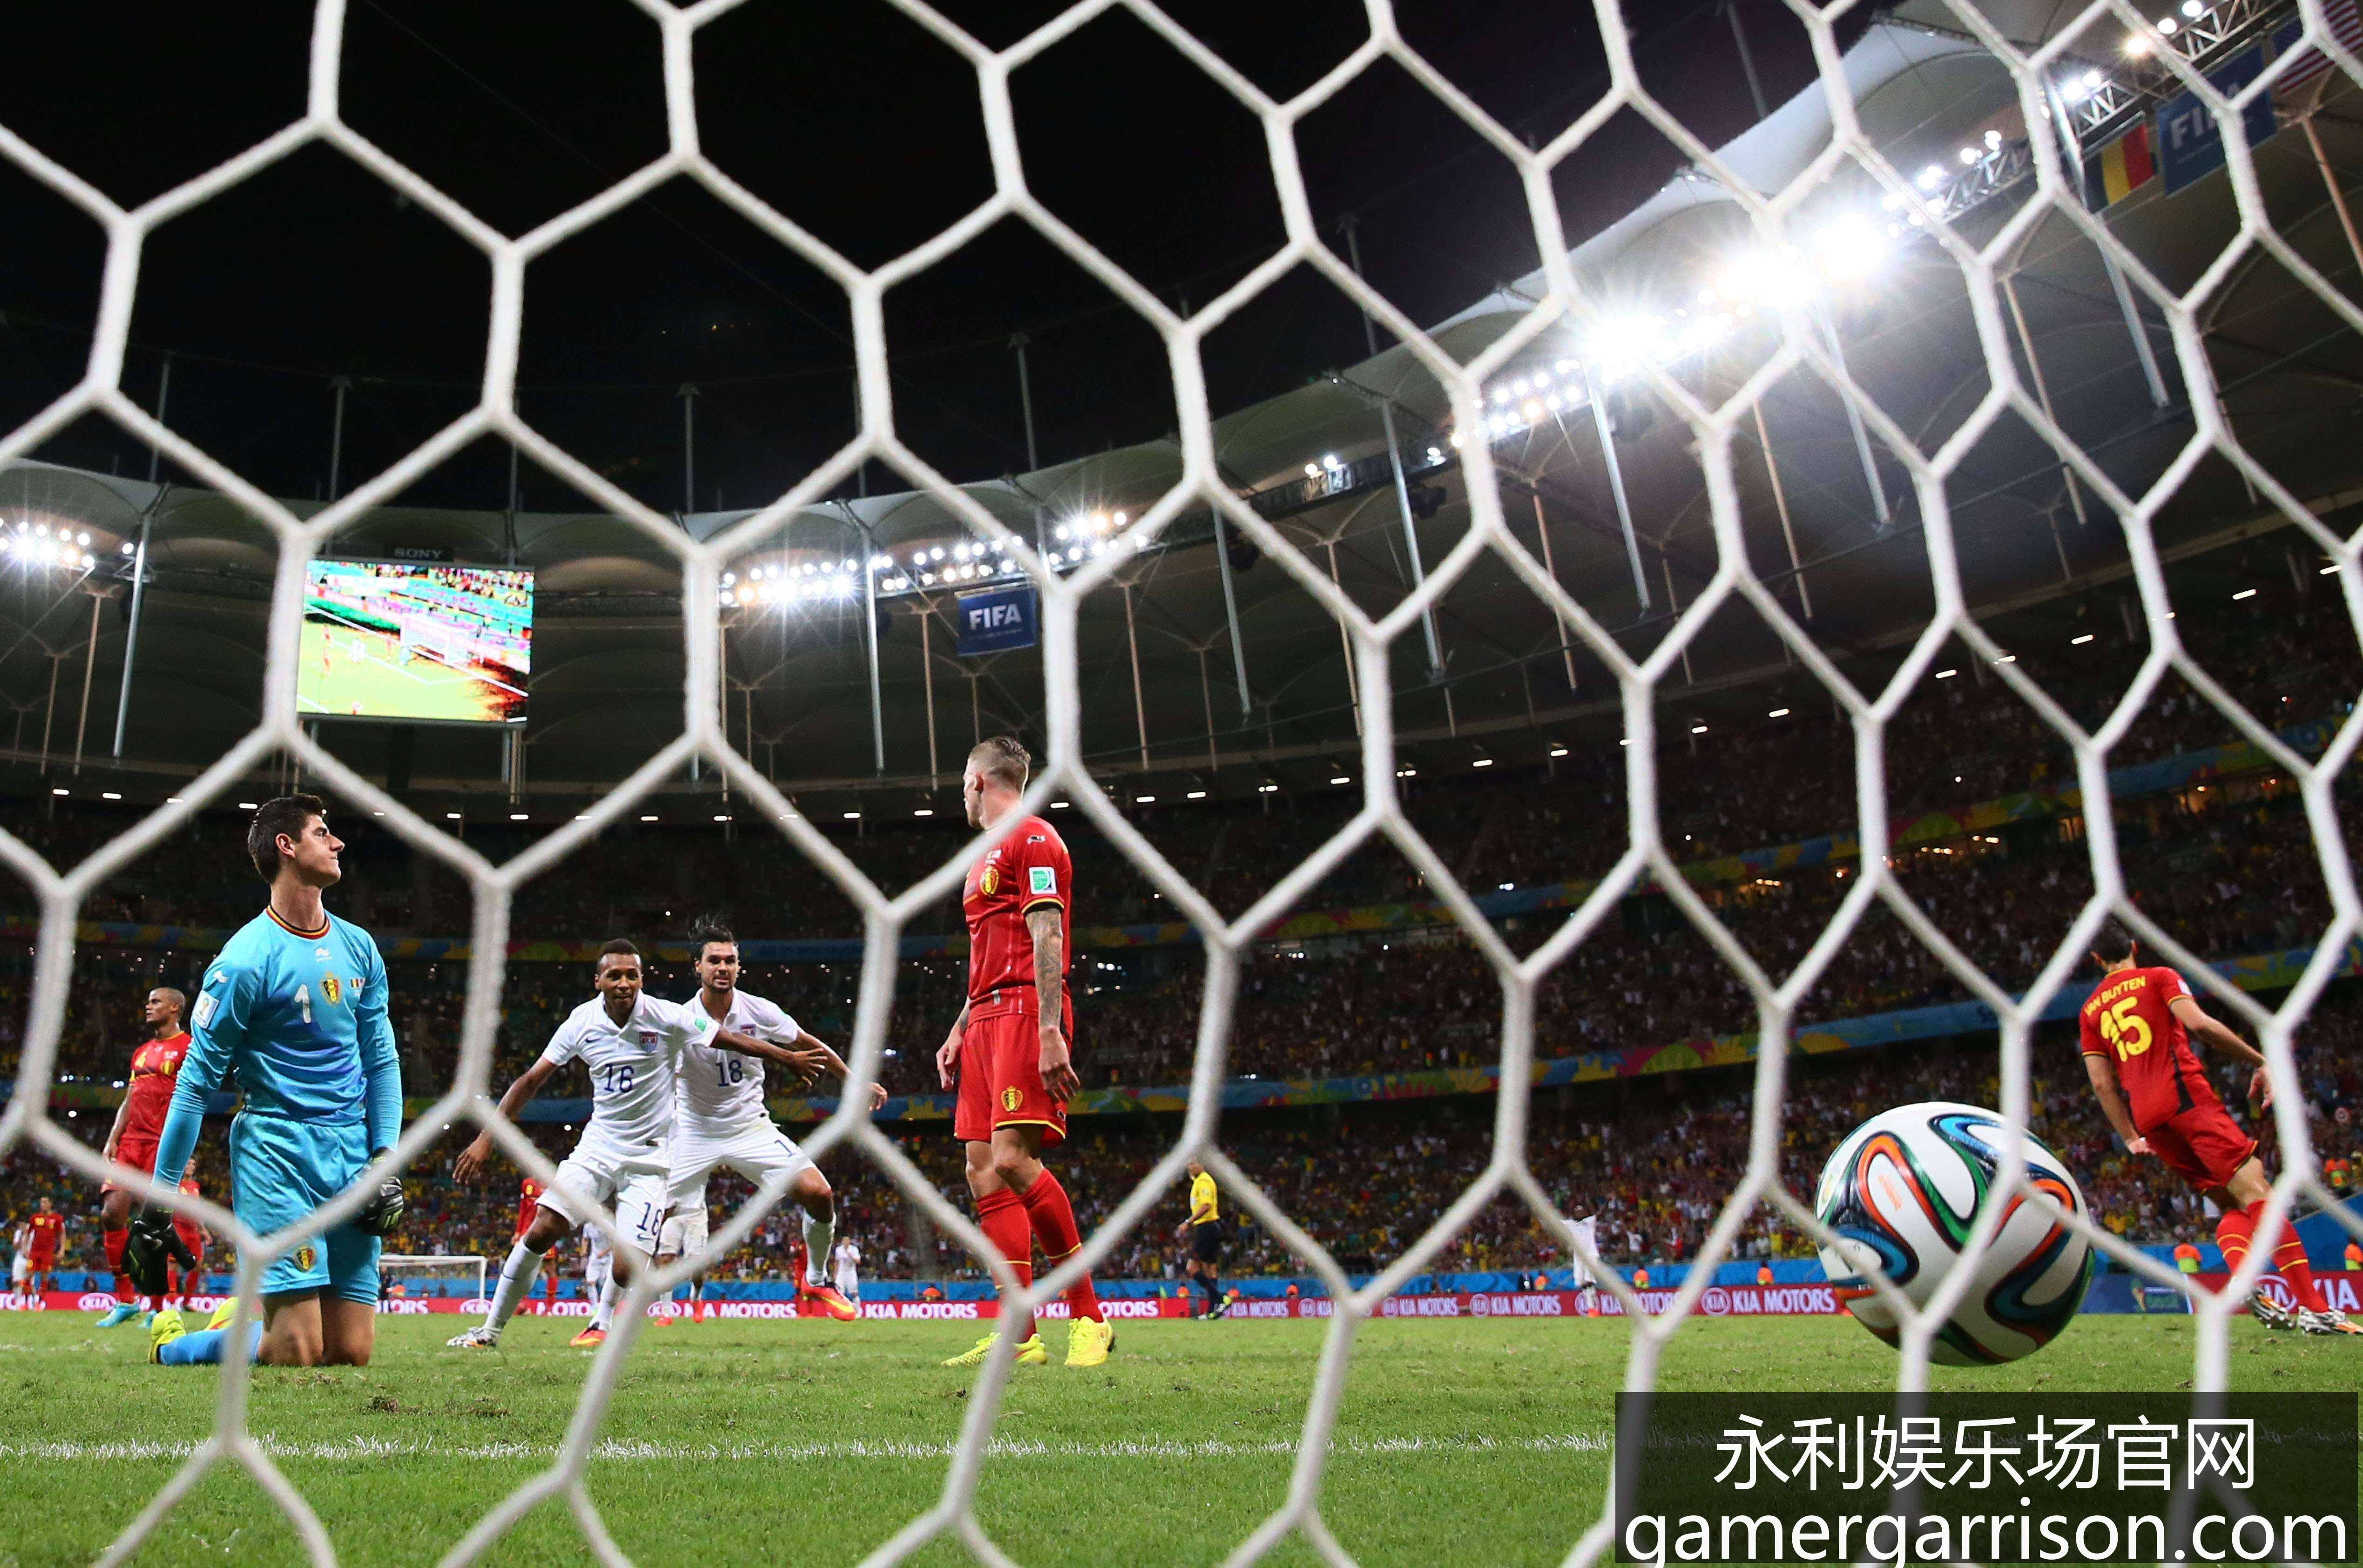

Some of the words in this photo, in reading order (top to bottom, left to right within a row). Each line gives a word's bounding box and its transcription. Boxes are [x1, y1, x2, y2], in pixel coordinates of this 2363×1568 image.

[394, 547, 443, 559] SONY
[969, 603, 1022, 630] FIFA
[2101, 975, 2146, 1004] BUYTEN
[294, 984, 311, 1023] 1
[2100, 996, 2152, 1062] 15
[605, 1063, 635, 1093] 16
[716, 1060, 743, 1087] 18
[719, 1303, 797, 1318] MOTORS
[865, 1304, 897, 1318] KIA
[901, 1303, 978, 1318] MOTORS
[1098, 1300, 1158, 1317] OTORS
[1249, 1301, 1289, 1317] MOTORS
[1399, 1298, 1417, 1315] KIA
[1418, 1297, 1459, 1316] MOTORS
[1491, 1296, 1512, 1314] KIA
[1512, 1295, 1561, 1315] MOTORS
[1732, 1290, 1761, 1312] KIA
[1763, 1288, 1836, 1313] MOTORS
